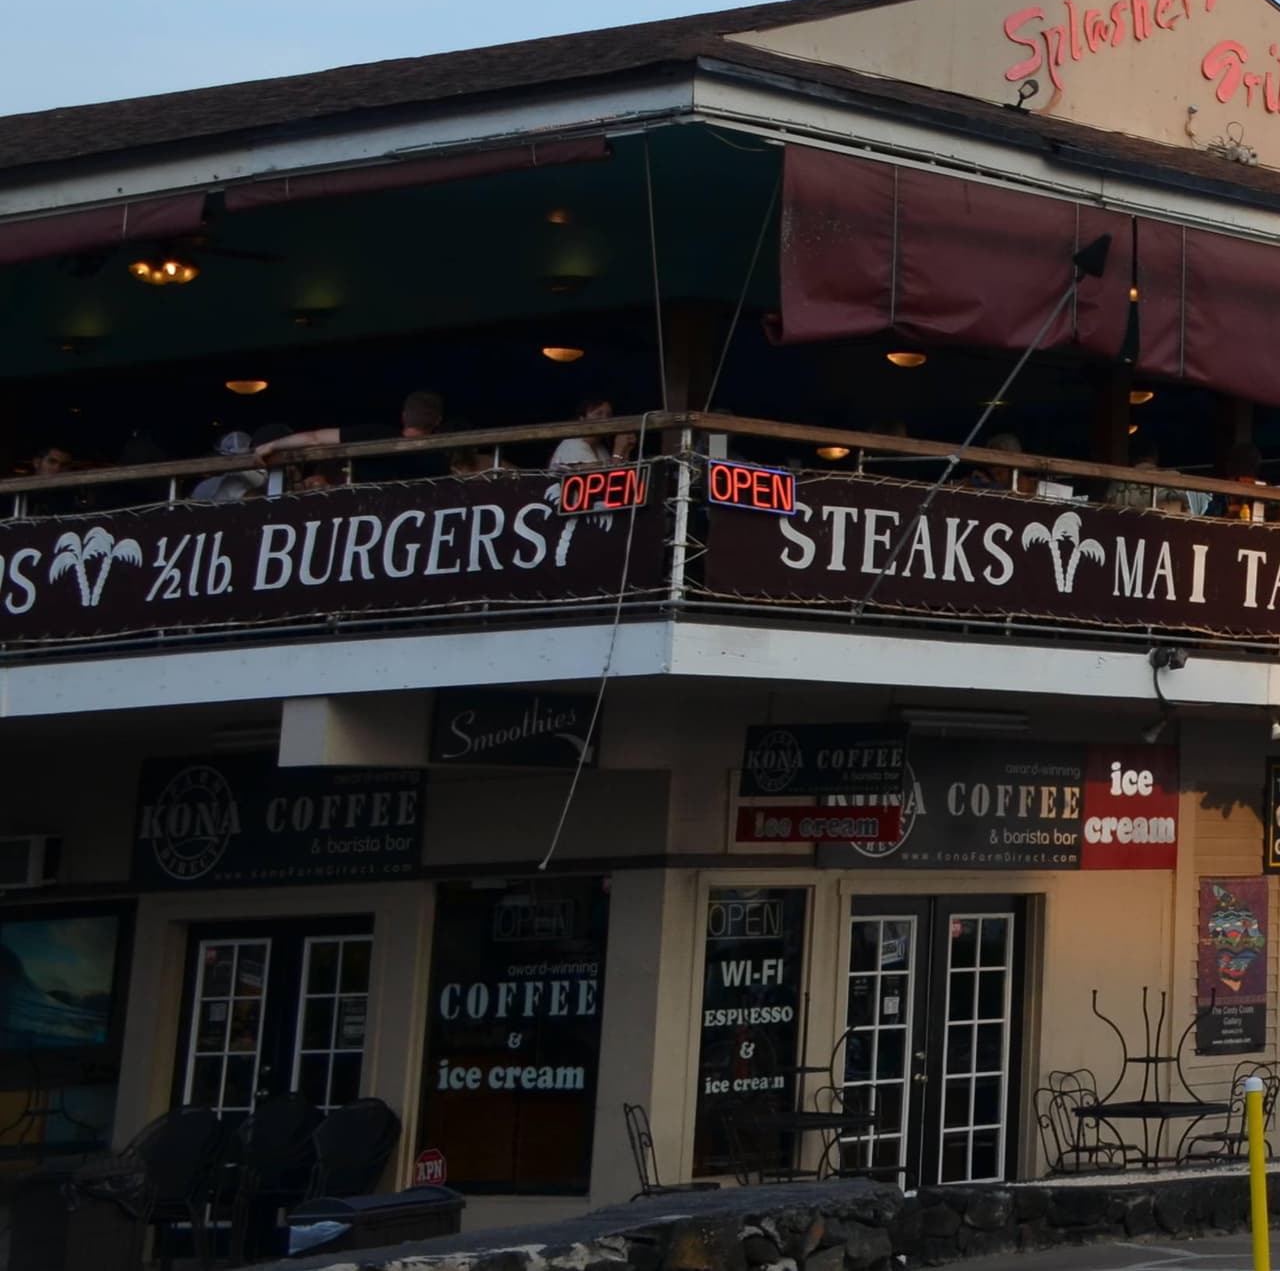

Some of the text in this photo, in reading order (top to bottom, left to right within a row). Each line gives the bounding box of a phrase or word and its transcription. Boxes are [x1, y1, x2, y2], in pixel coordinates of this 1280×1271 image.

[561, 470, 646, 512] OPEN
[711, 466, 792, 512] OPEN
[253, 502, 553, 591] BURGERS
[778, 501, 1014, 586] STEAKS
[1113, 536, 1208, 604] MAI
[442, 695, 577, 759] Smoothies
[747, 747, 904, 769] KONA COFFEE
[1110, 760, 1154, 796] ice
[139, 790, 417, 839] KONA COFFEE
[946, 782, 1081, 819] COFFEE
[799, 817, 879, 838] cream
[990, 829, 1078, 845] & barista bar
[1084, 816, 1176, 844] cream
[709, 903, 780, 937] OPEN
[507, 960, 599, 977] award-winning
[721, 959, 784, 988] WI-FI
[439, 979, 598, 1021] COFFEE
[507, 1032, 522, 1049] &
[739, 1041, 755, 1059] &
[437, 1058, 585, 1090] ice cream
[704, 1076, 730, 1095] ice
